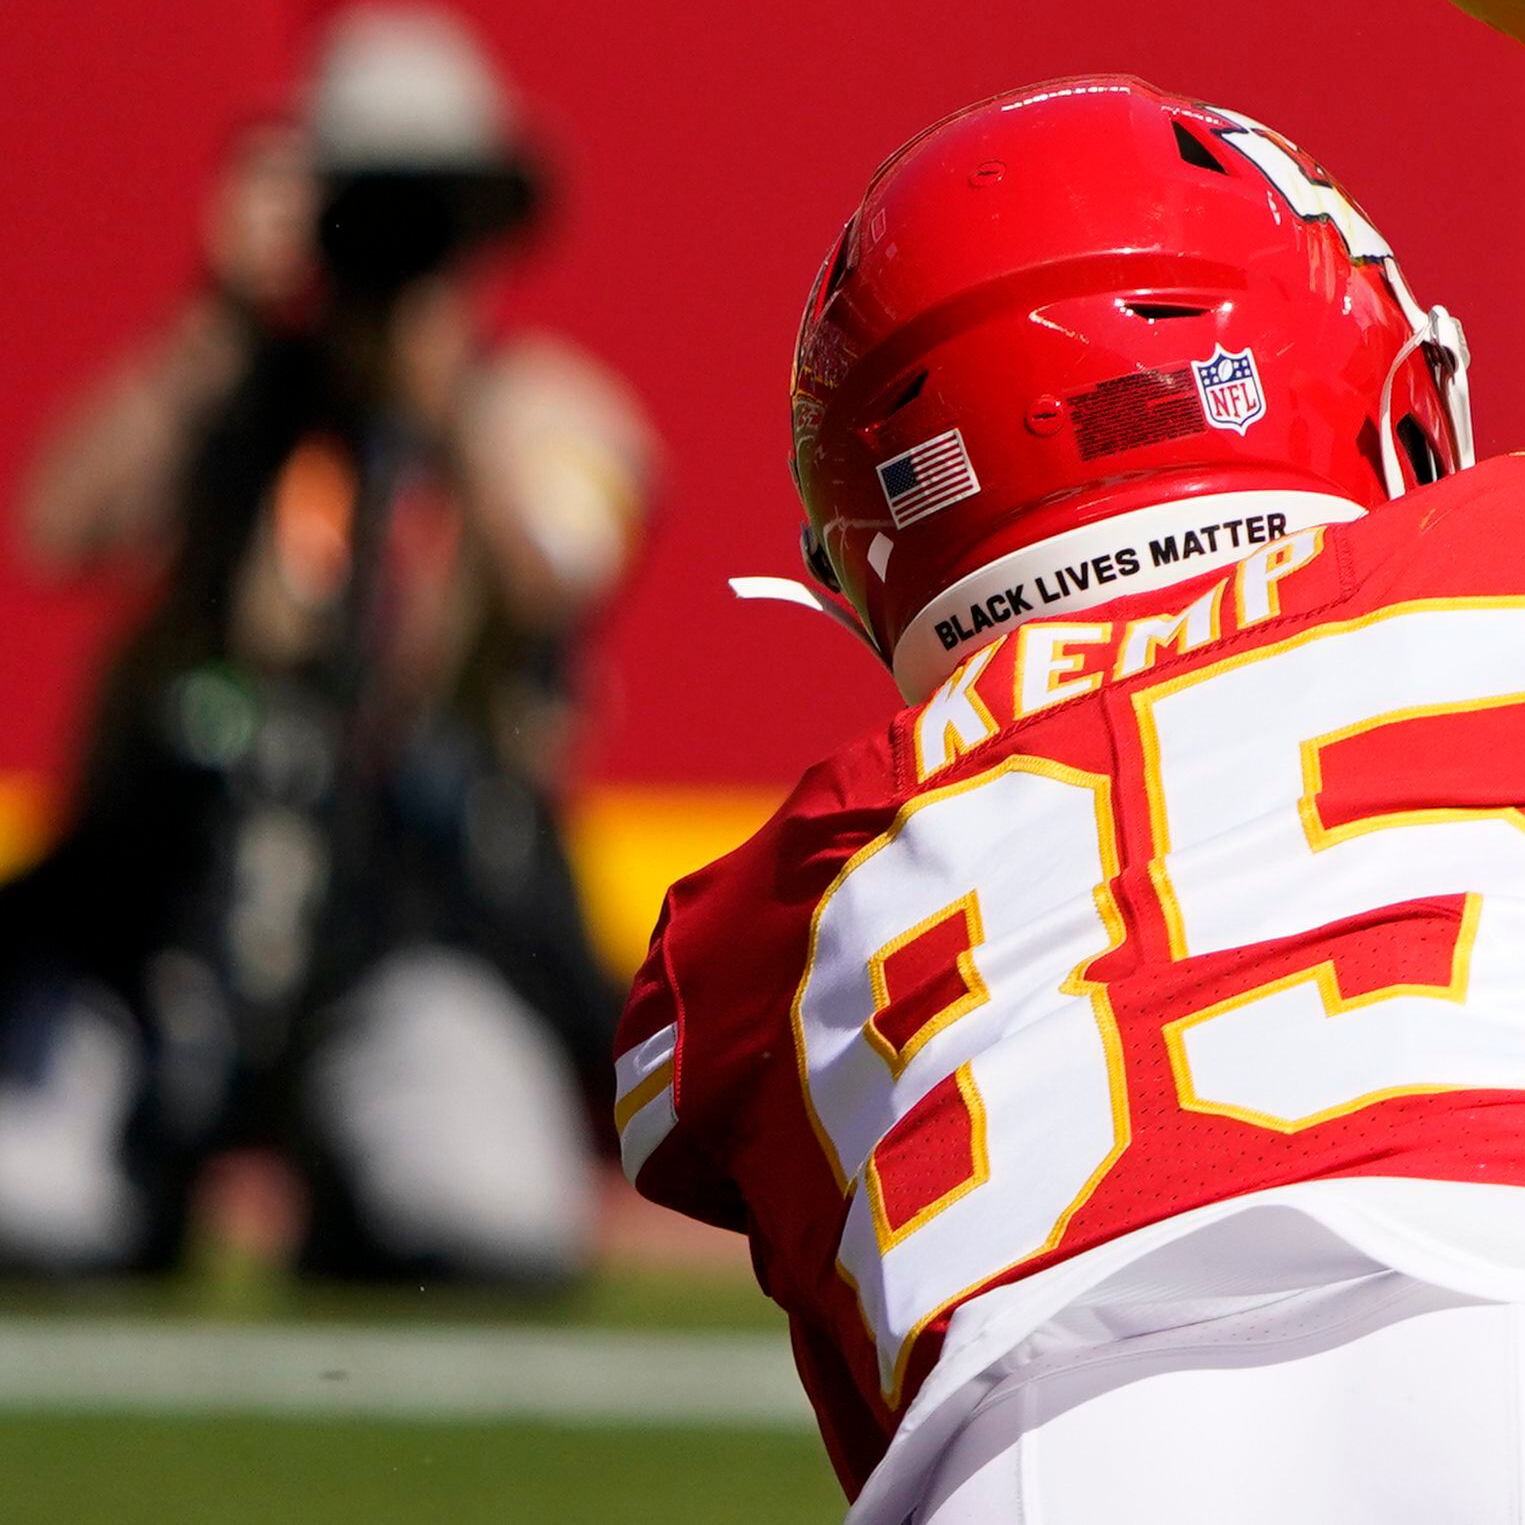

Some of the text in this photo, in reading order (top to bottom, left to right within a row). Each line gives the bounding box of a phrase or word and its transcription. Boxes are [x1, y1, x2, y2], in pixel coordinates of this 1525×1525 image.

[1210, 381, 1257, 418] NFL
[934, 512, 1288, 651] BLACK LIVES MATTER
[914, 524, 1329, 784] KEMP
